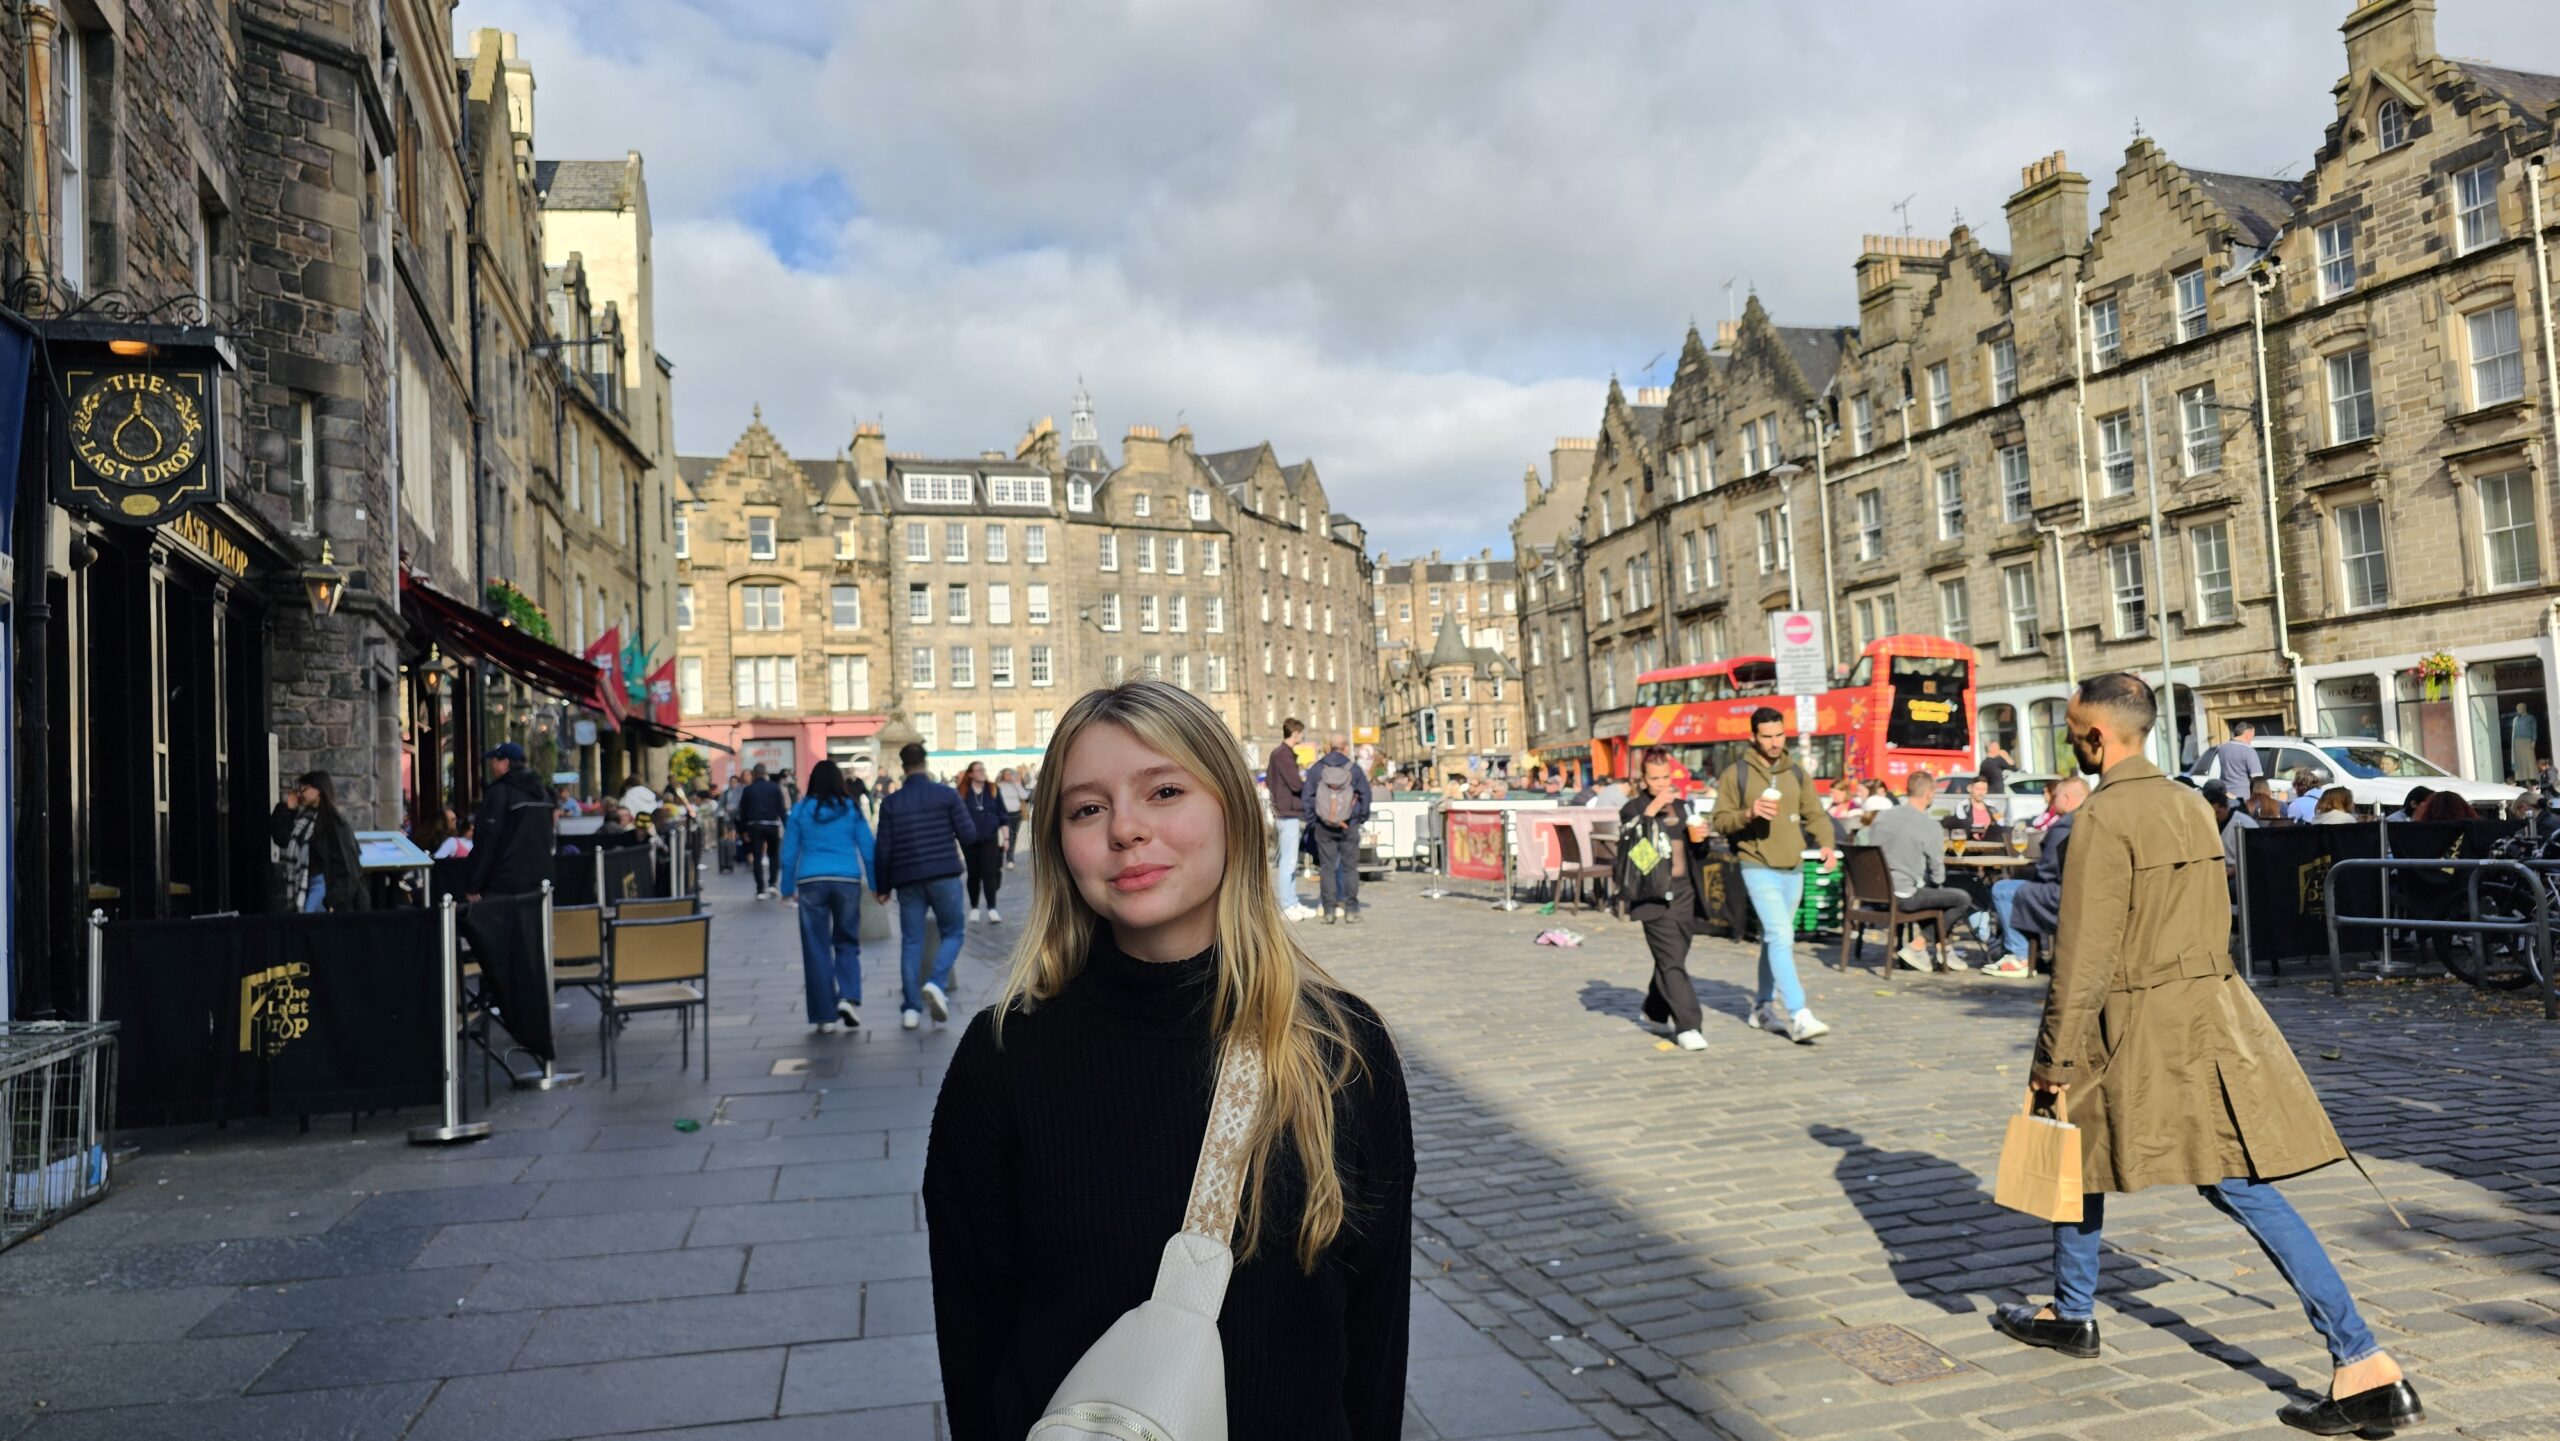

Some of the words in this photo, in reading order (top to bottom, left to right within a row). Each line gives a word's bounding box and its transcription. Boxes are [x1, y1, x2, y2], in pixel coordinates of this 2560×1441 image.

[107, 373, 164, 394] THE
[80, 440, 135, 481] LAST
[141, 441, 194, 482] DROP
[213, 527, 248, 577] DROP
[275, 984, 310, 999] The
[268, 1001, 309, 1015] Last
